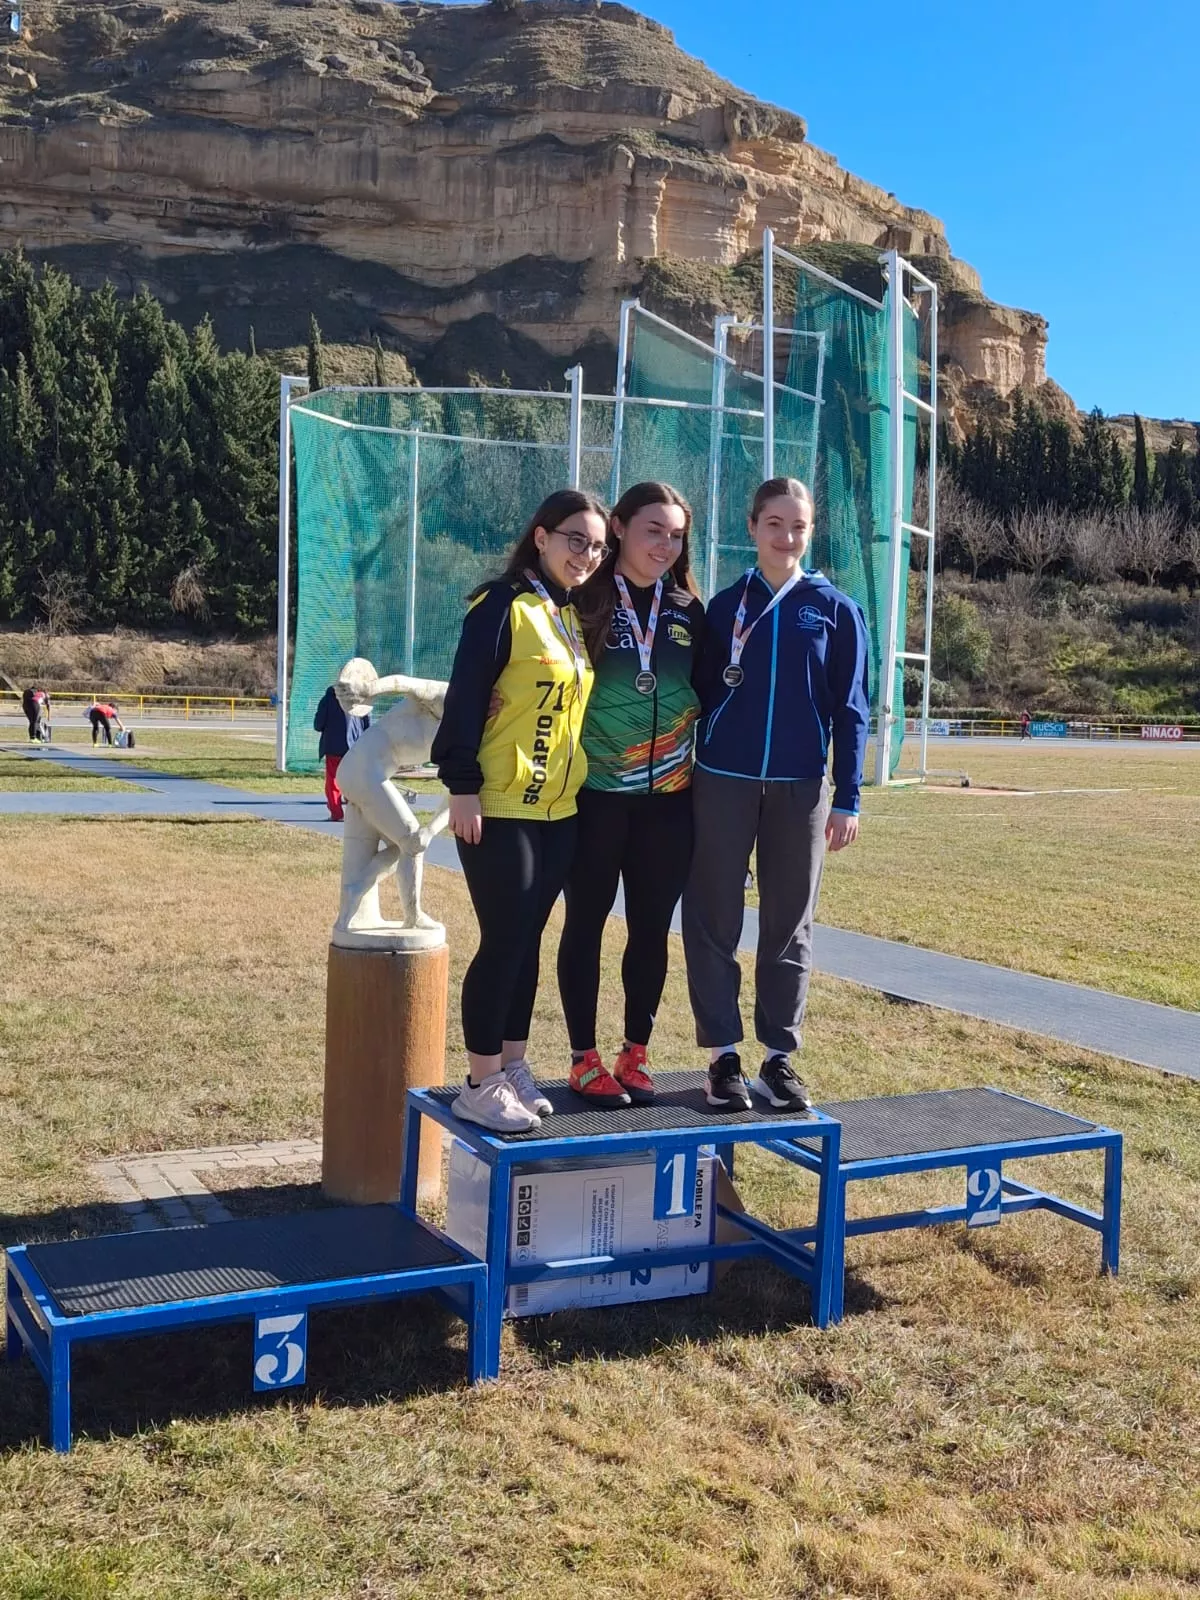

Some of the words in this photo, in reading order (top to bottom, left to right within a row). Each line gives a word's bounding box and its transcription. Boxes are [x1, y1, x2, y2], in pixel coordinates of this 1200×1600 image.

[536, 681, 565, 711] 71
[1141, 726, 1181, 739] HINACO
[523, 715, 553, 805] SCORPIO
[579, 1067, 601, 1088] NIKE
[662, 1153, 688, 1216] 1
[695, 1168, 704, 1211] MOBILE
[967, 1168, 1001, 1226] 2
[694, 1213, 702, 1229] PA
[254, 1312, 305, 1385] 3
